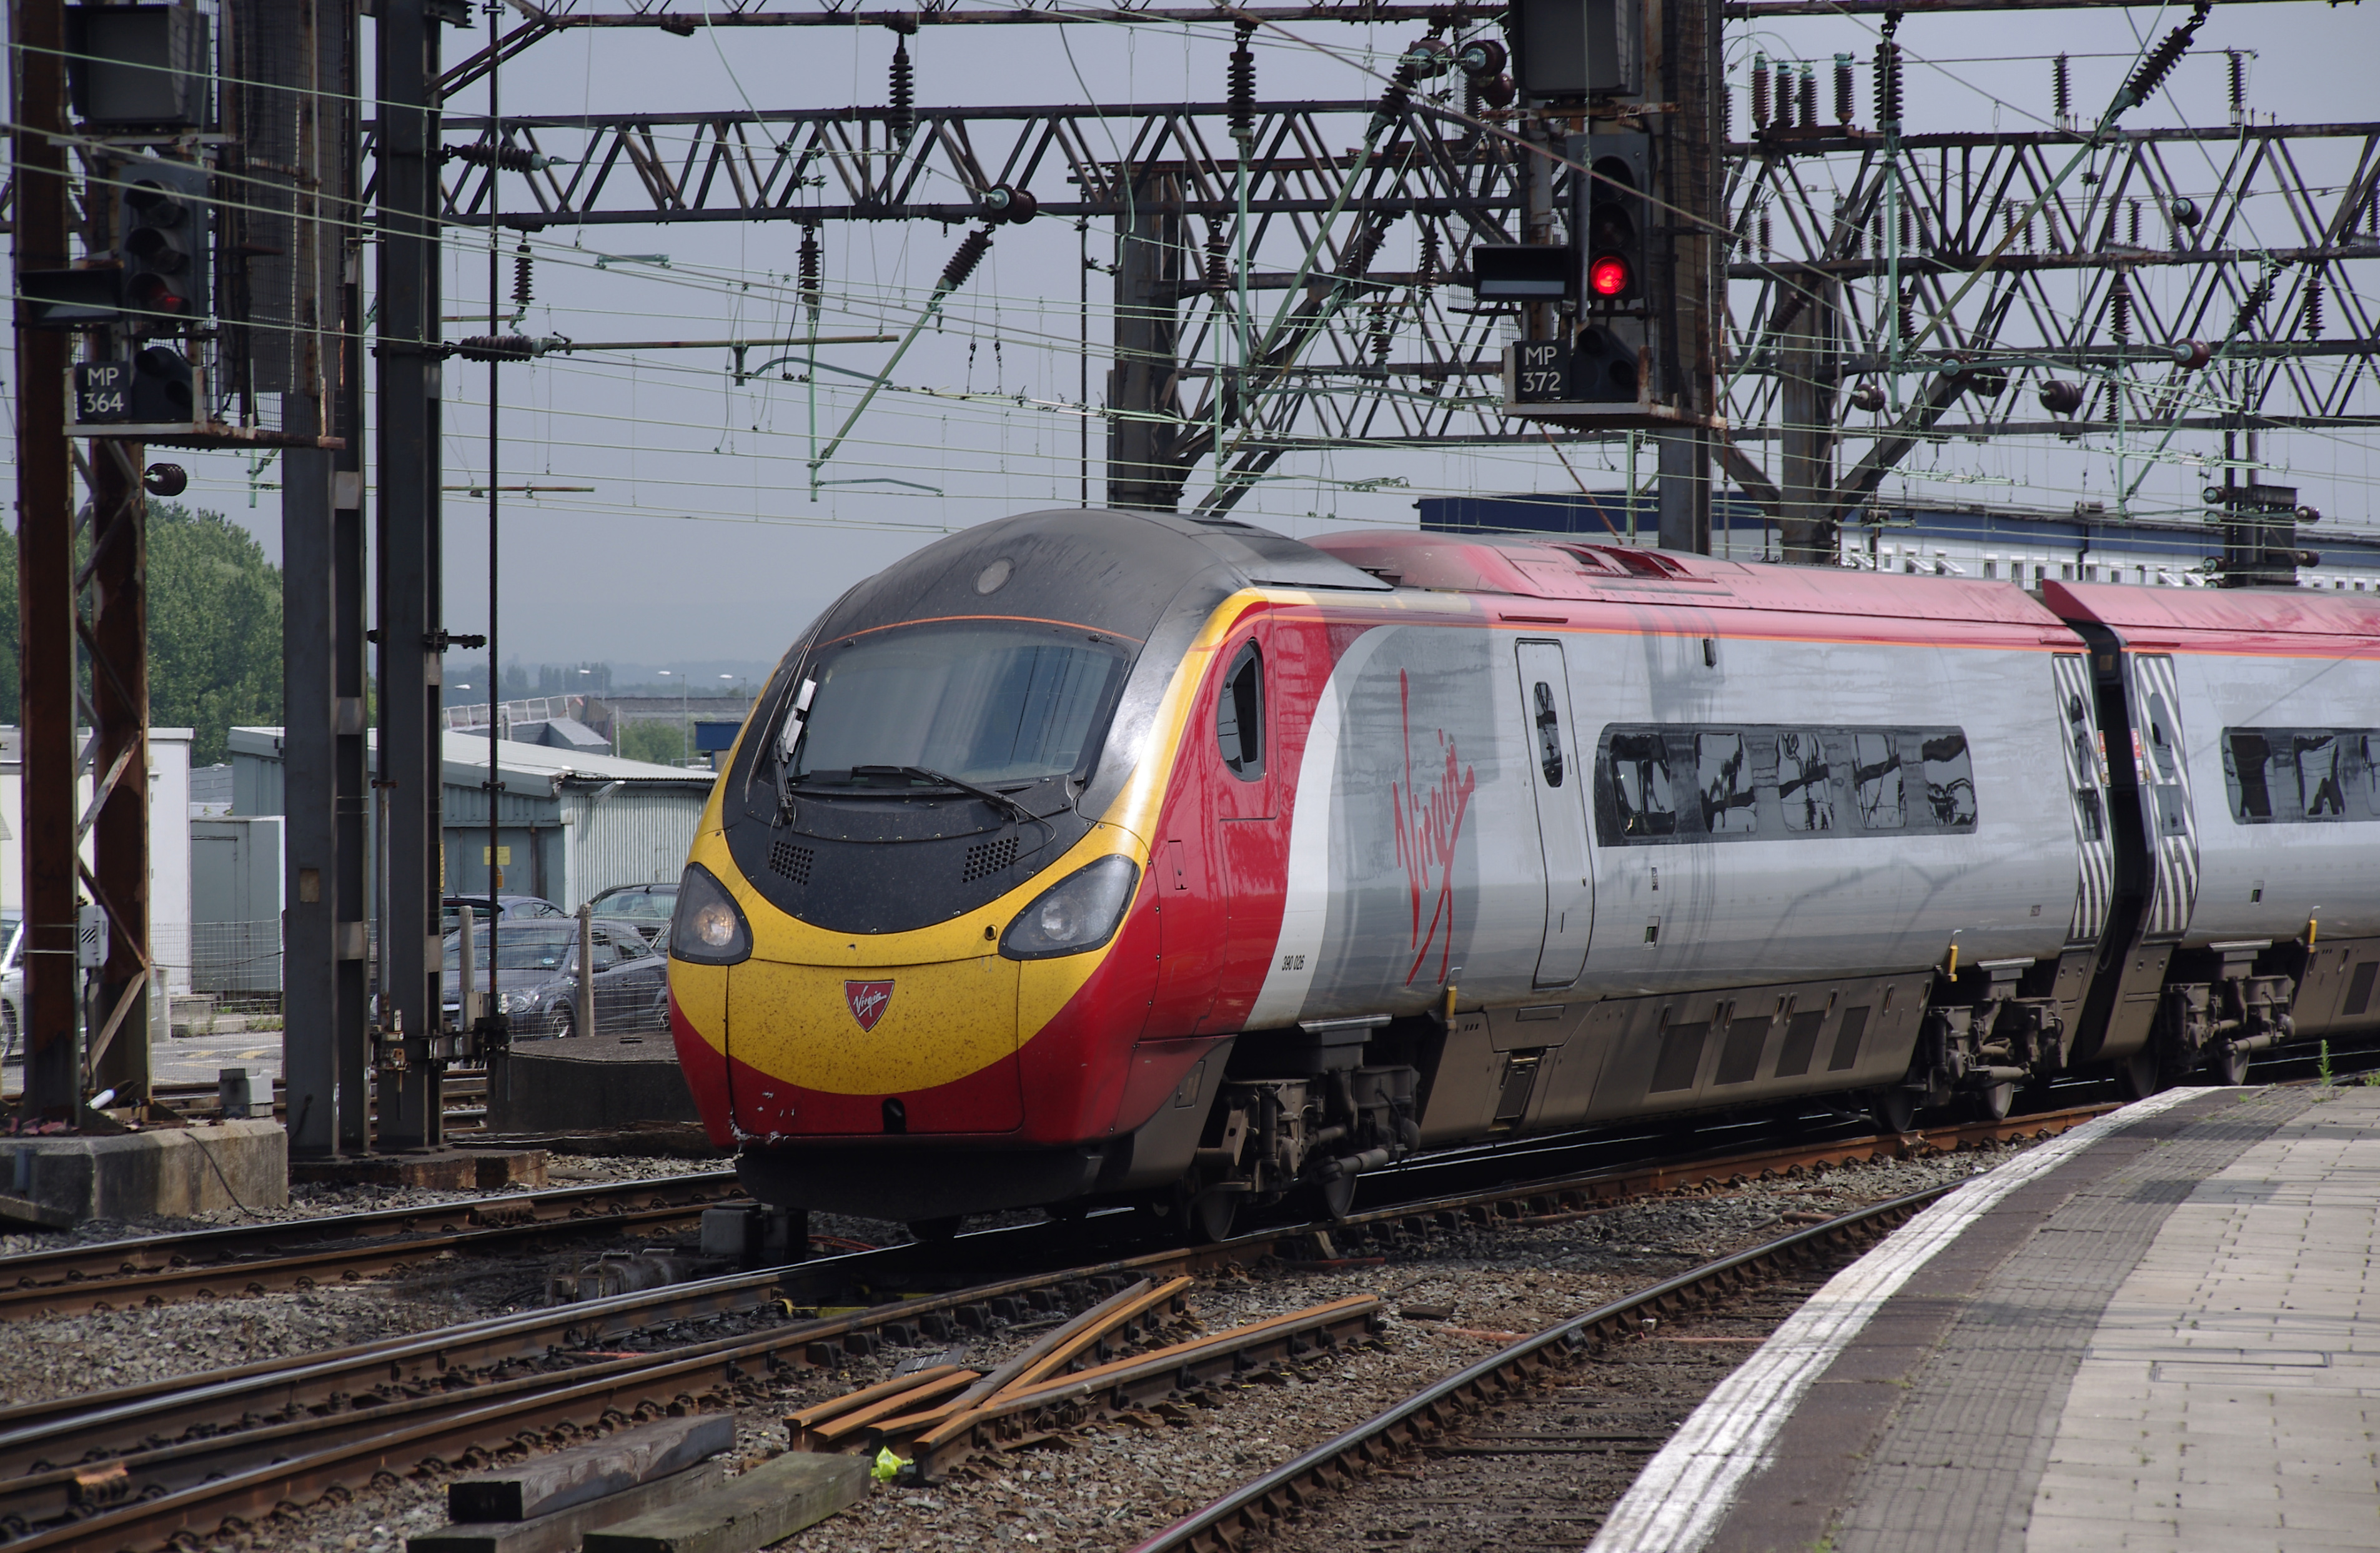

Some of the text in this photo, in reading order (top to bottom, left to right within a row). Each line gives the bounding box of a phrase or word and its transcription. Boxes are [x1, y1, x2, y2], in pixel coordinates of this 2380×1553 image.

[1525, 345, 1557, 365] MP
[87, 367, 119, 386] MP
[1522, 371, 1561, 392] 372
[84, 392, 124, 413] 364
[1392, 667, 1475, 987] Virgin
[1282, 955, 1305, 971] 390 026
[853, 985, 887, 1017] Virgin
